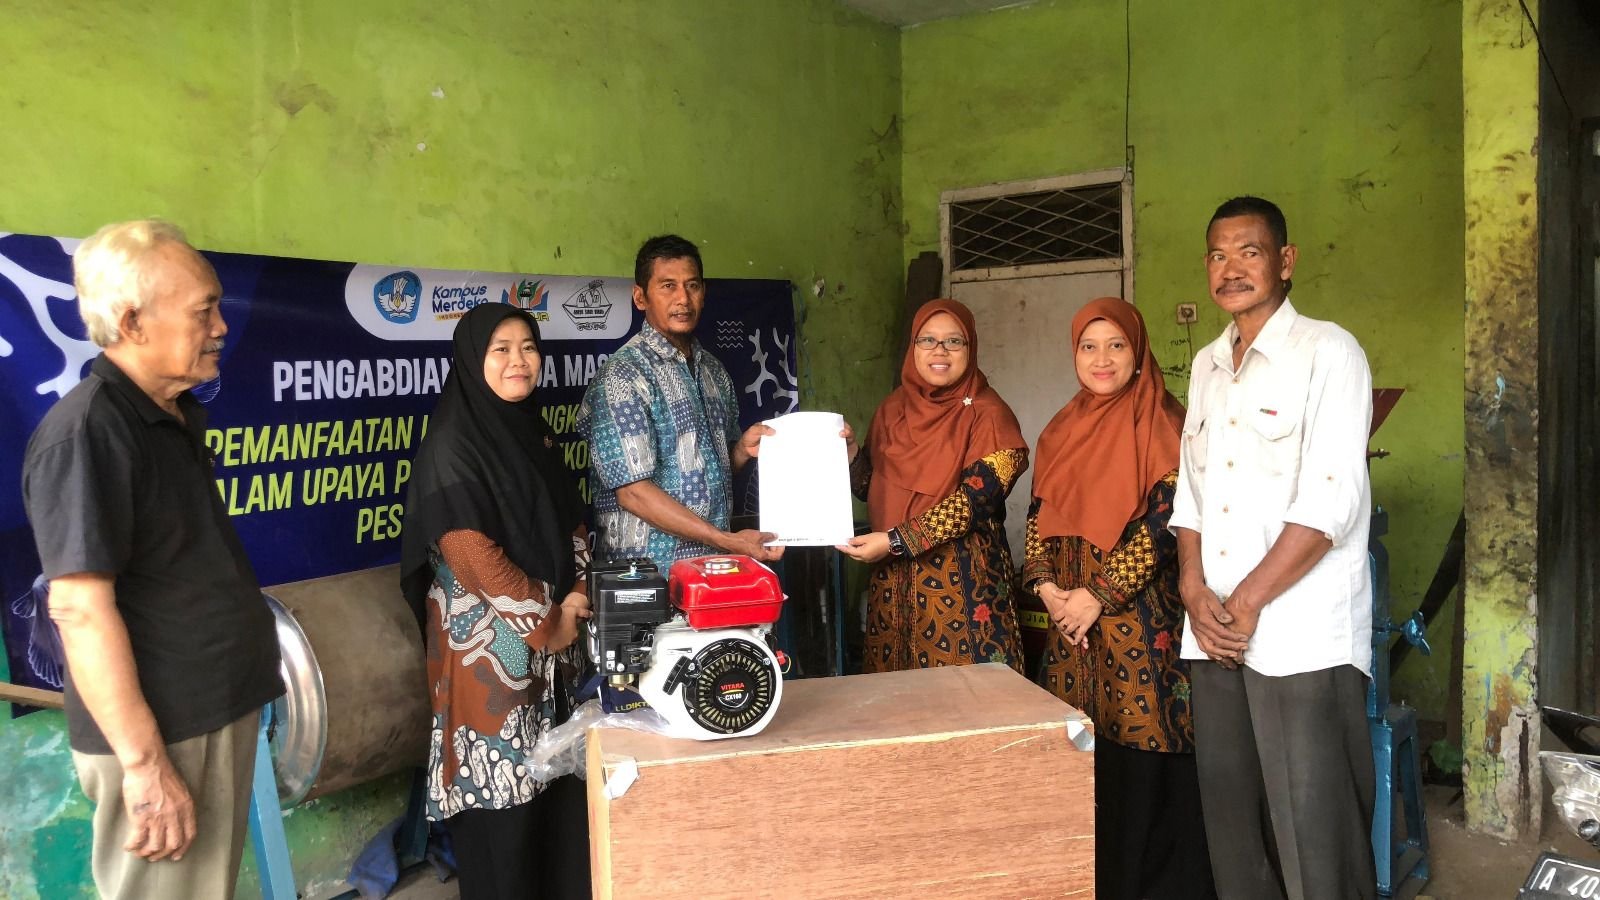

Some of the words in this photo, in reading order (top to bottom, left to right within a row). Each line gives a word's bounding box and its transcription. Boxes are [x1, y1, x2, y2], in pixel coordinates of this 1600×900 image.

[432, 285, 487, 301] Kampus
[205, 415, 414, 467] PEMANFAATAN
[303, 462, 385, 506] UPAYA
[720, 682, 745, 691] VITARA
[1538, 867, 1557, 891] A
[1567, 875, 1600, 900] 40
